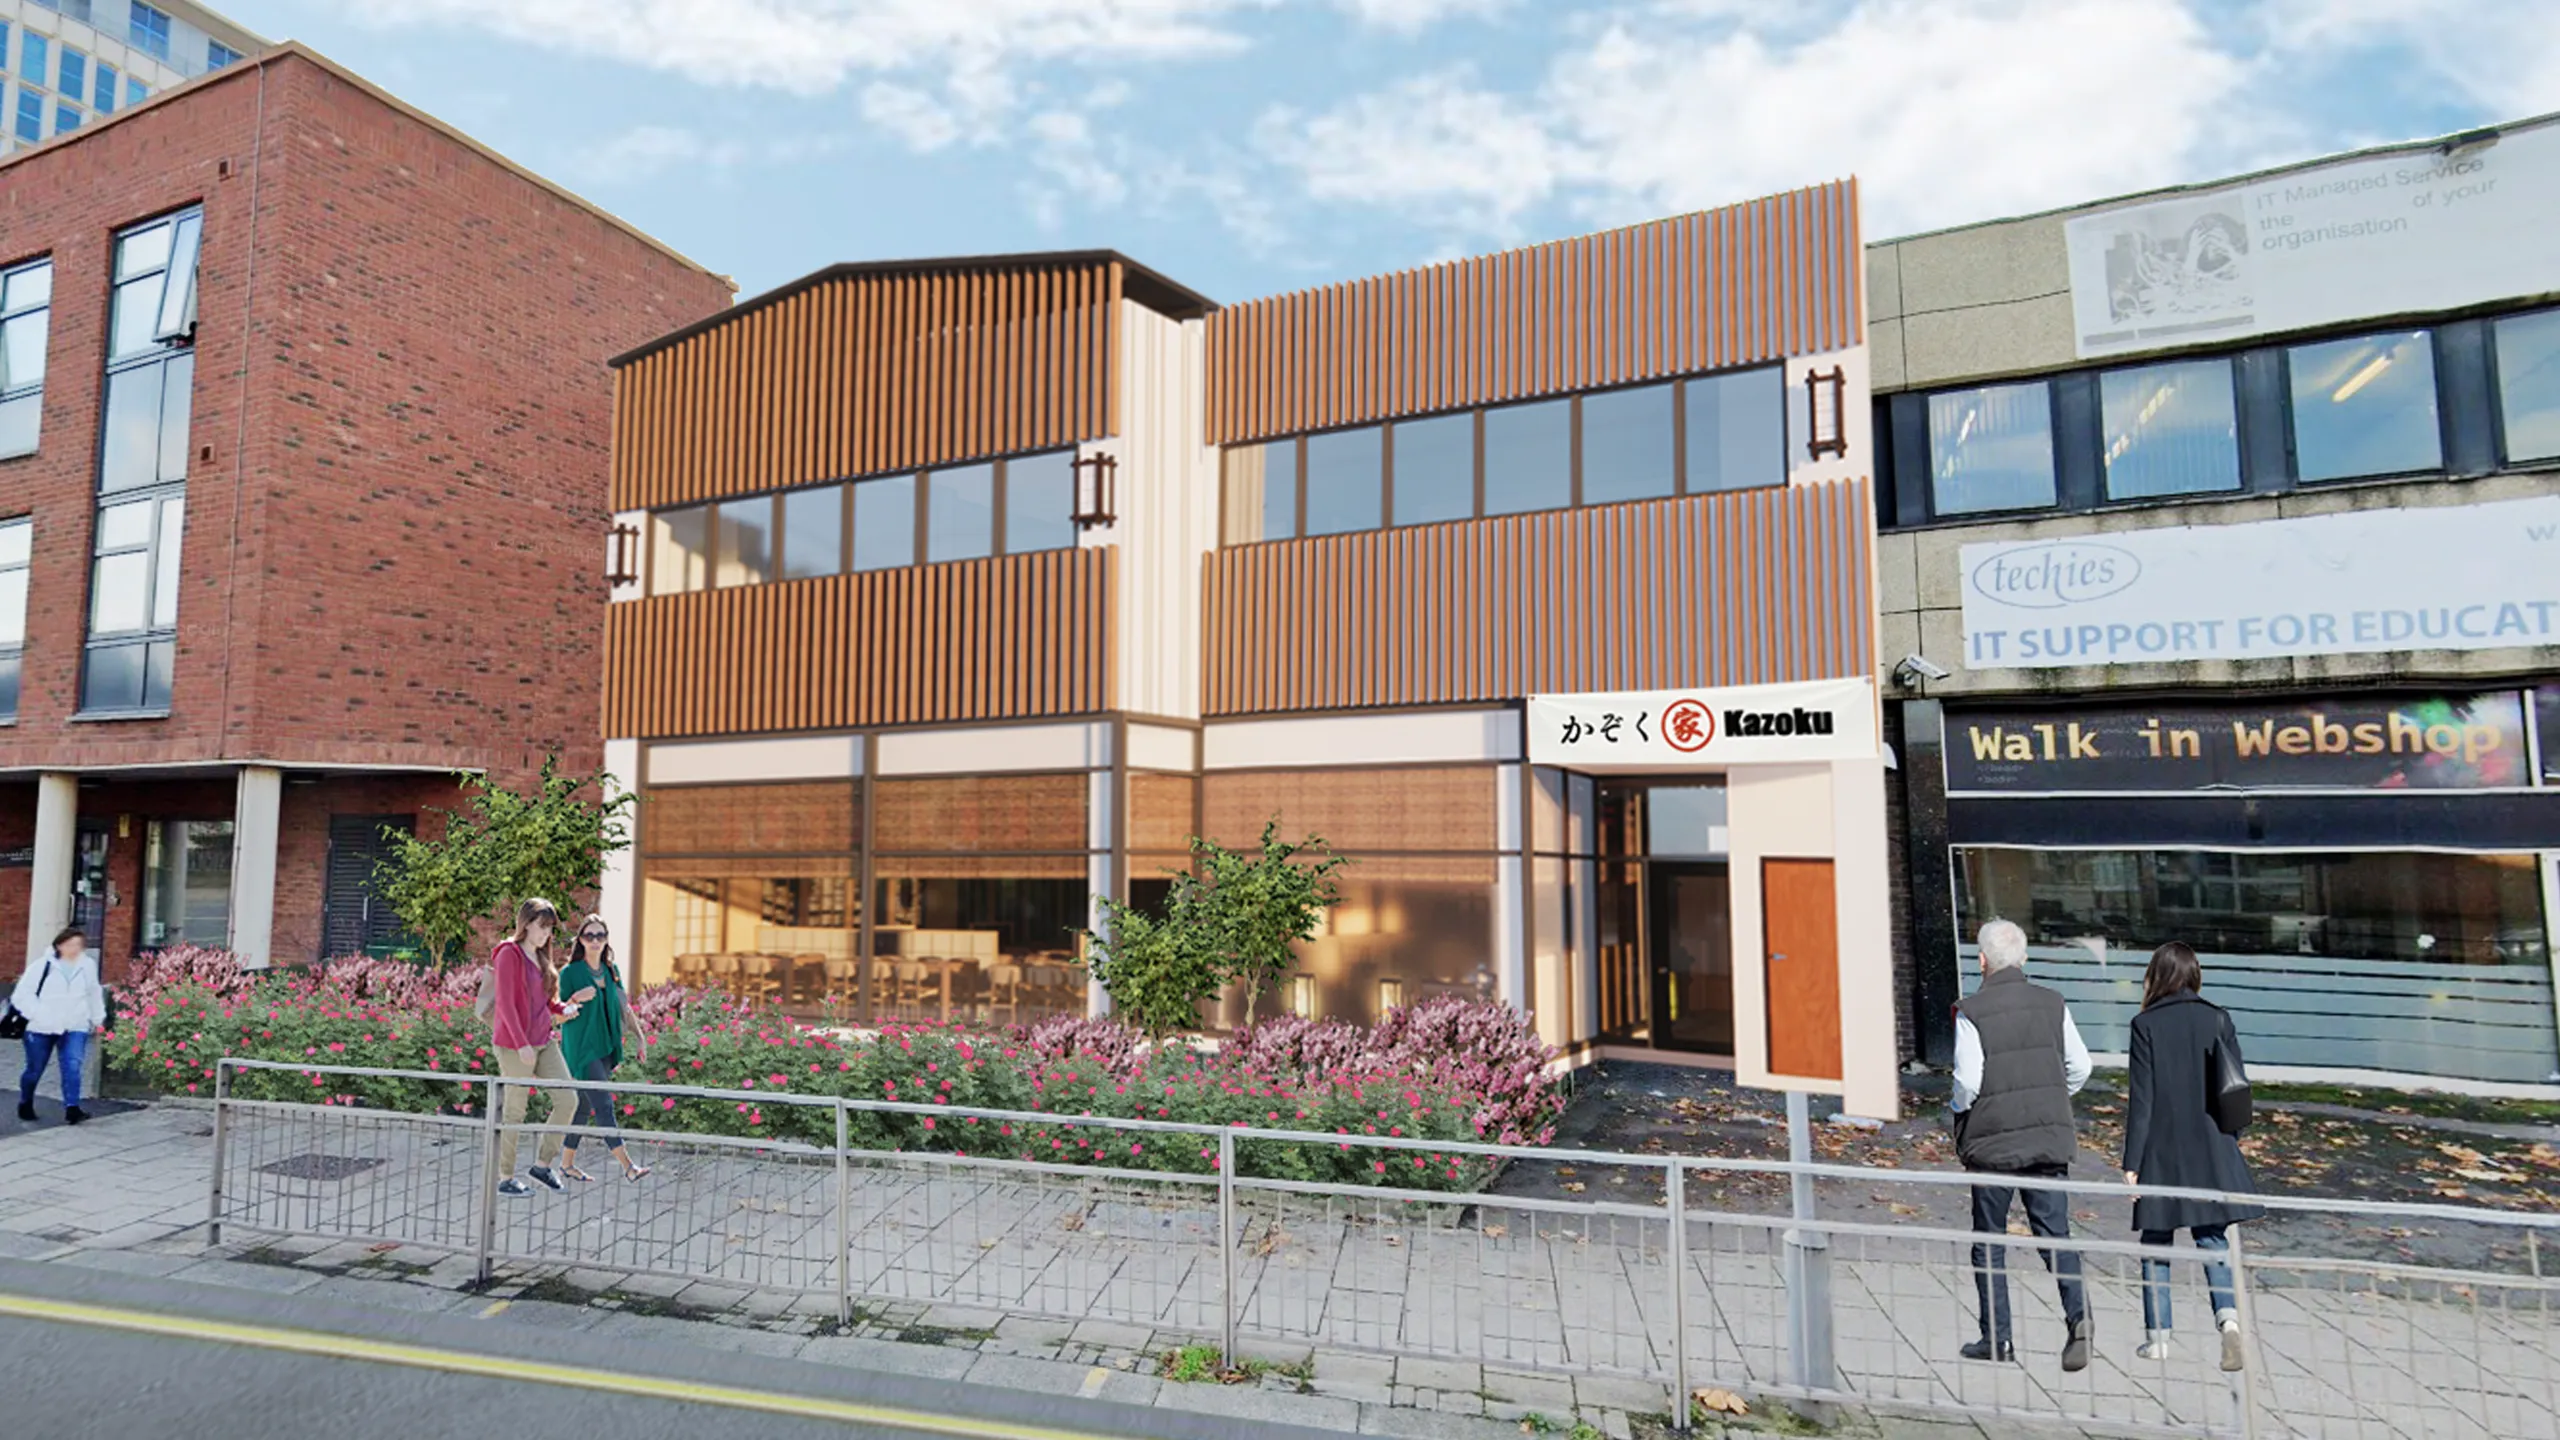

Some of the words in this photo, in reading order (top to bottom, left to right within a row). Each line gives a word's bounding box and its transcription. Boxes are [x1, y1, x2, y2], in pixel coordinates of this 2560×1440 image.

[2255, 191, 2277, 210] IT
[2284, 172, 2388, 204] Managed
[2395, 158, 2484, 186] Service
[2260, 214, 2294, 231] the
[2412, 190, 2433, 208] of
[2441, 177, 2498, 207] your
[2262, 216, 2408, 250] organisation
[1993, 551, 2116, 602] techies
[1973, 630, 2008, 660] IT
[2019, 619, 2224, 659] SUPPORT
[2238, 612, 2338, 649] FOR
[2351, 600, 2560, 644] EDUCAT
[1560, 711, 1650, 744] かぞく
[1724, 707, 1834, 738] Kazoku
[1969, 722, 2100, 761] Walk
[2137, 718, 2201, 758] in
[2232, 710, 2500, 764] Webshop
